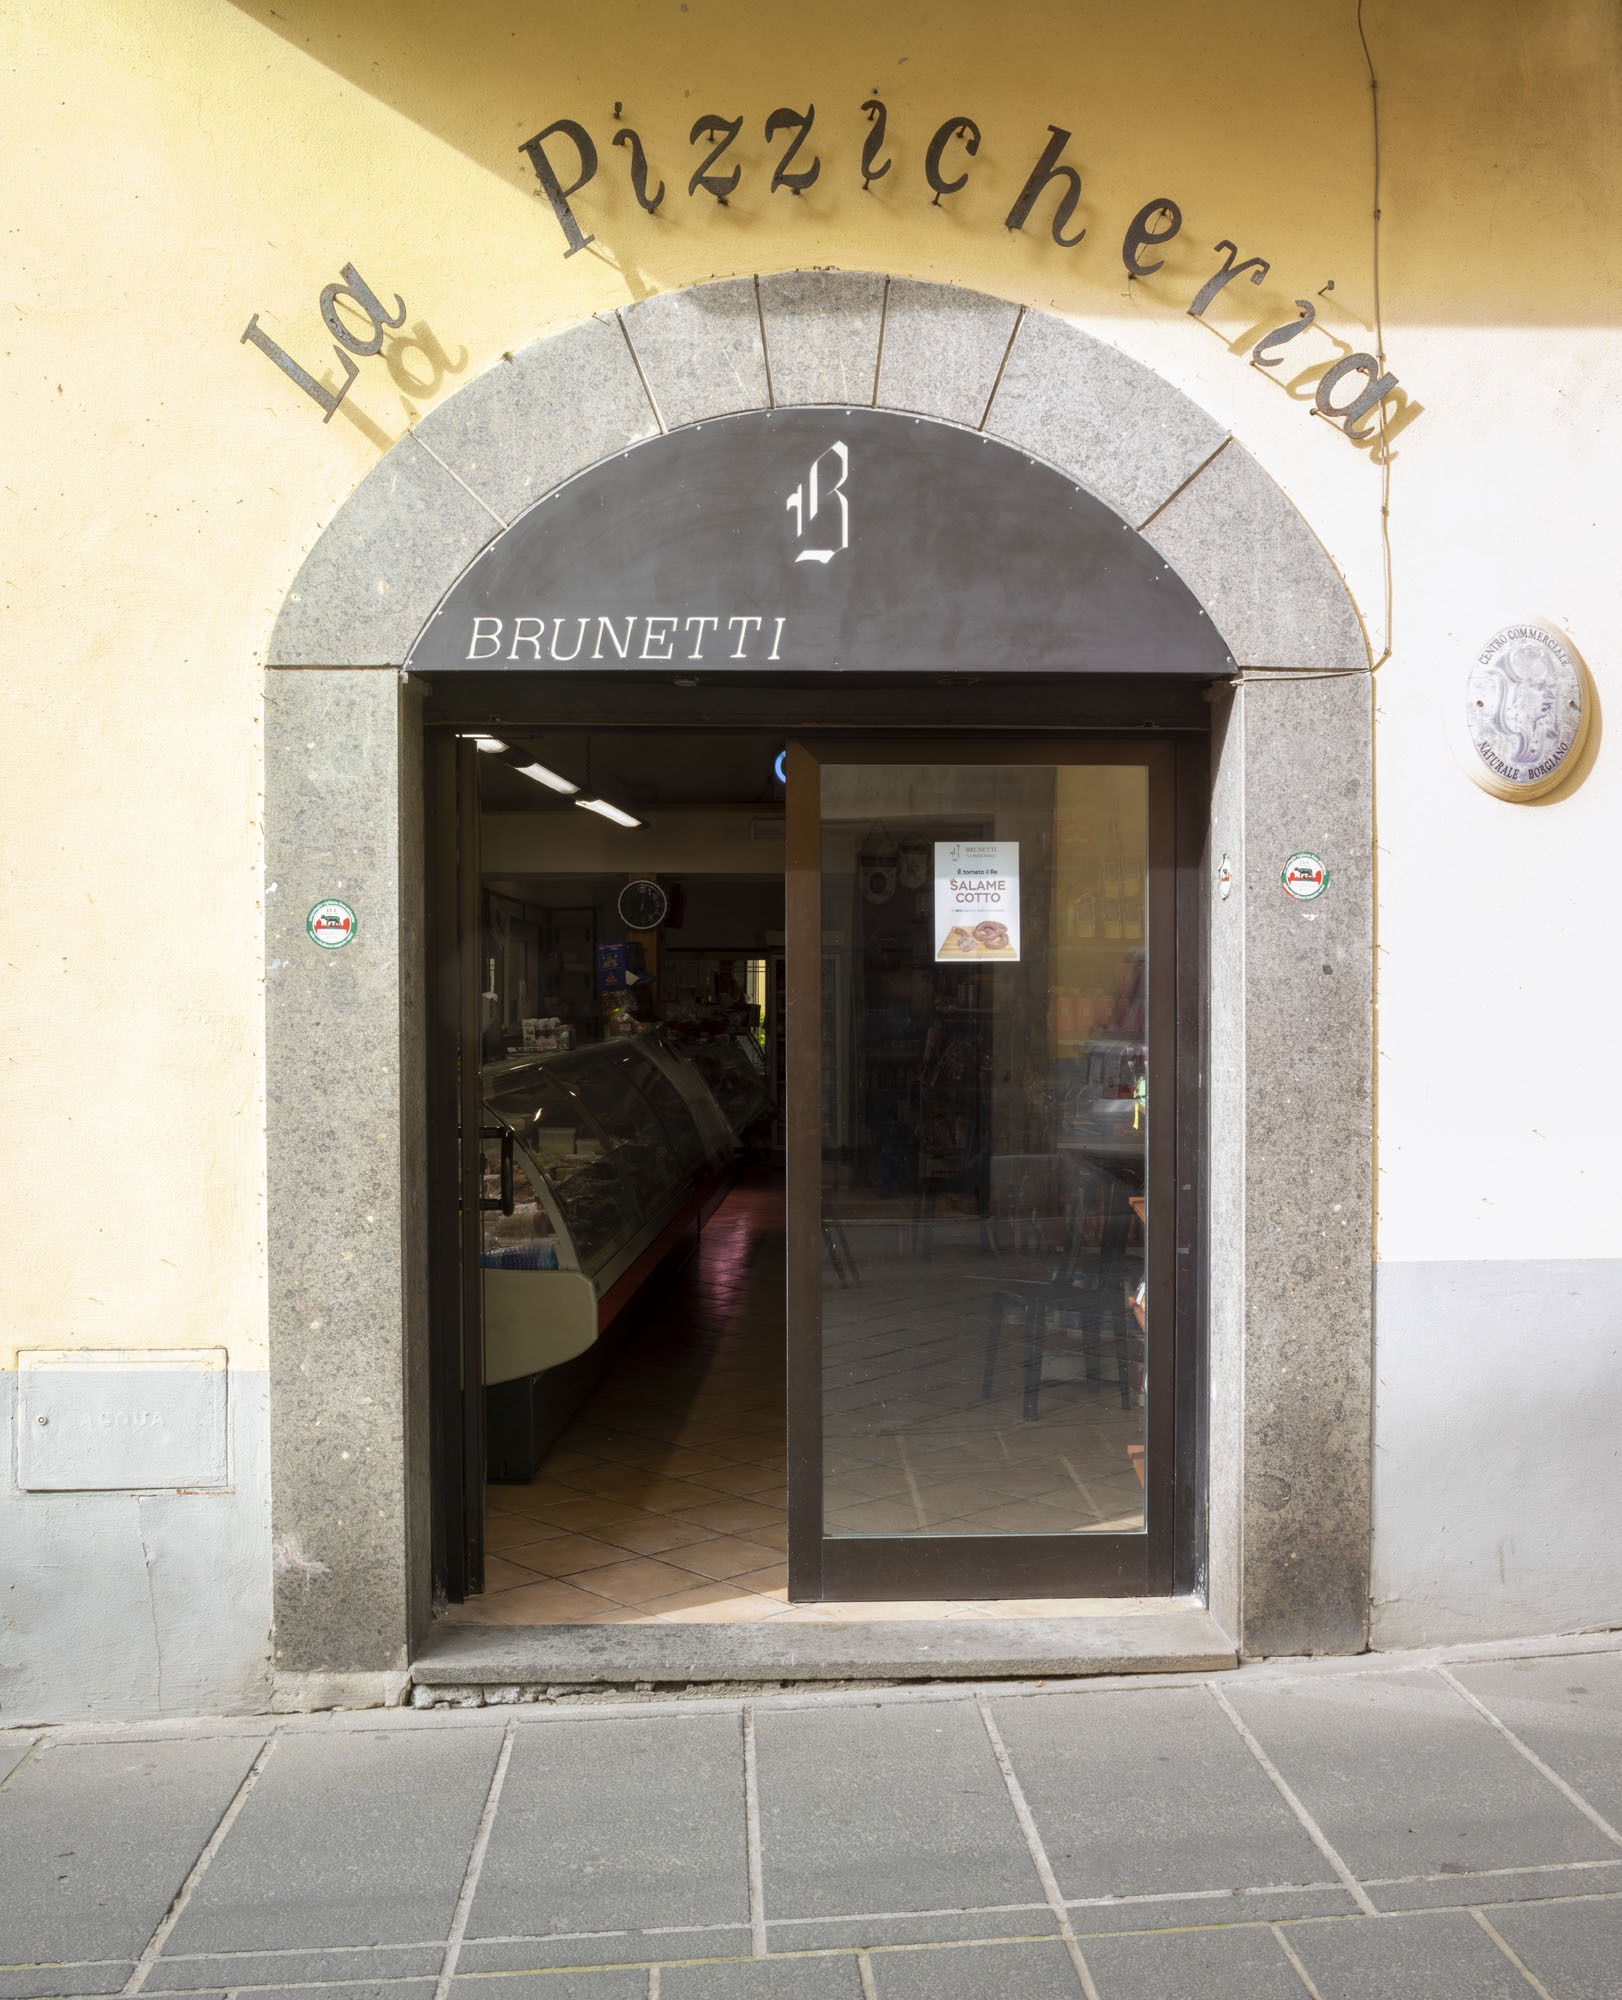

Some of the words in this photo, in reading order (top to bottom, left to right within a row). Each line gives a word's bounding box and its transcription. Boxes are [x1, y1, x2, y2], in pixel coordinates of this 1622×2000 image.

[240, 262, 407, 424] La
[518, 89, 1400, 440] Pizzicheria
[465, 616, 787, 661] BRUNETTI
[1479, 632, 1507, 666] CENTRO
[1507, 628, 1571, 667] COMMERCIALE
[1477, 740, 1520, 780] NATURALE
[1527, 742, 1569, 780] BORGIANO
[950, 880, 1006, 891] SALAME
[955, 892, 1001, 903] COTTO
